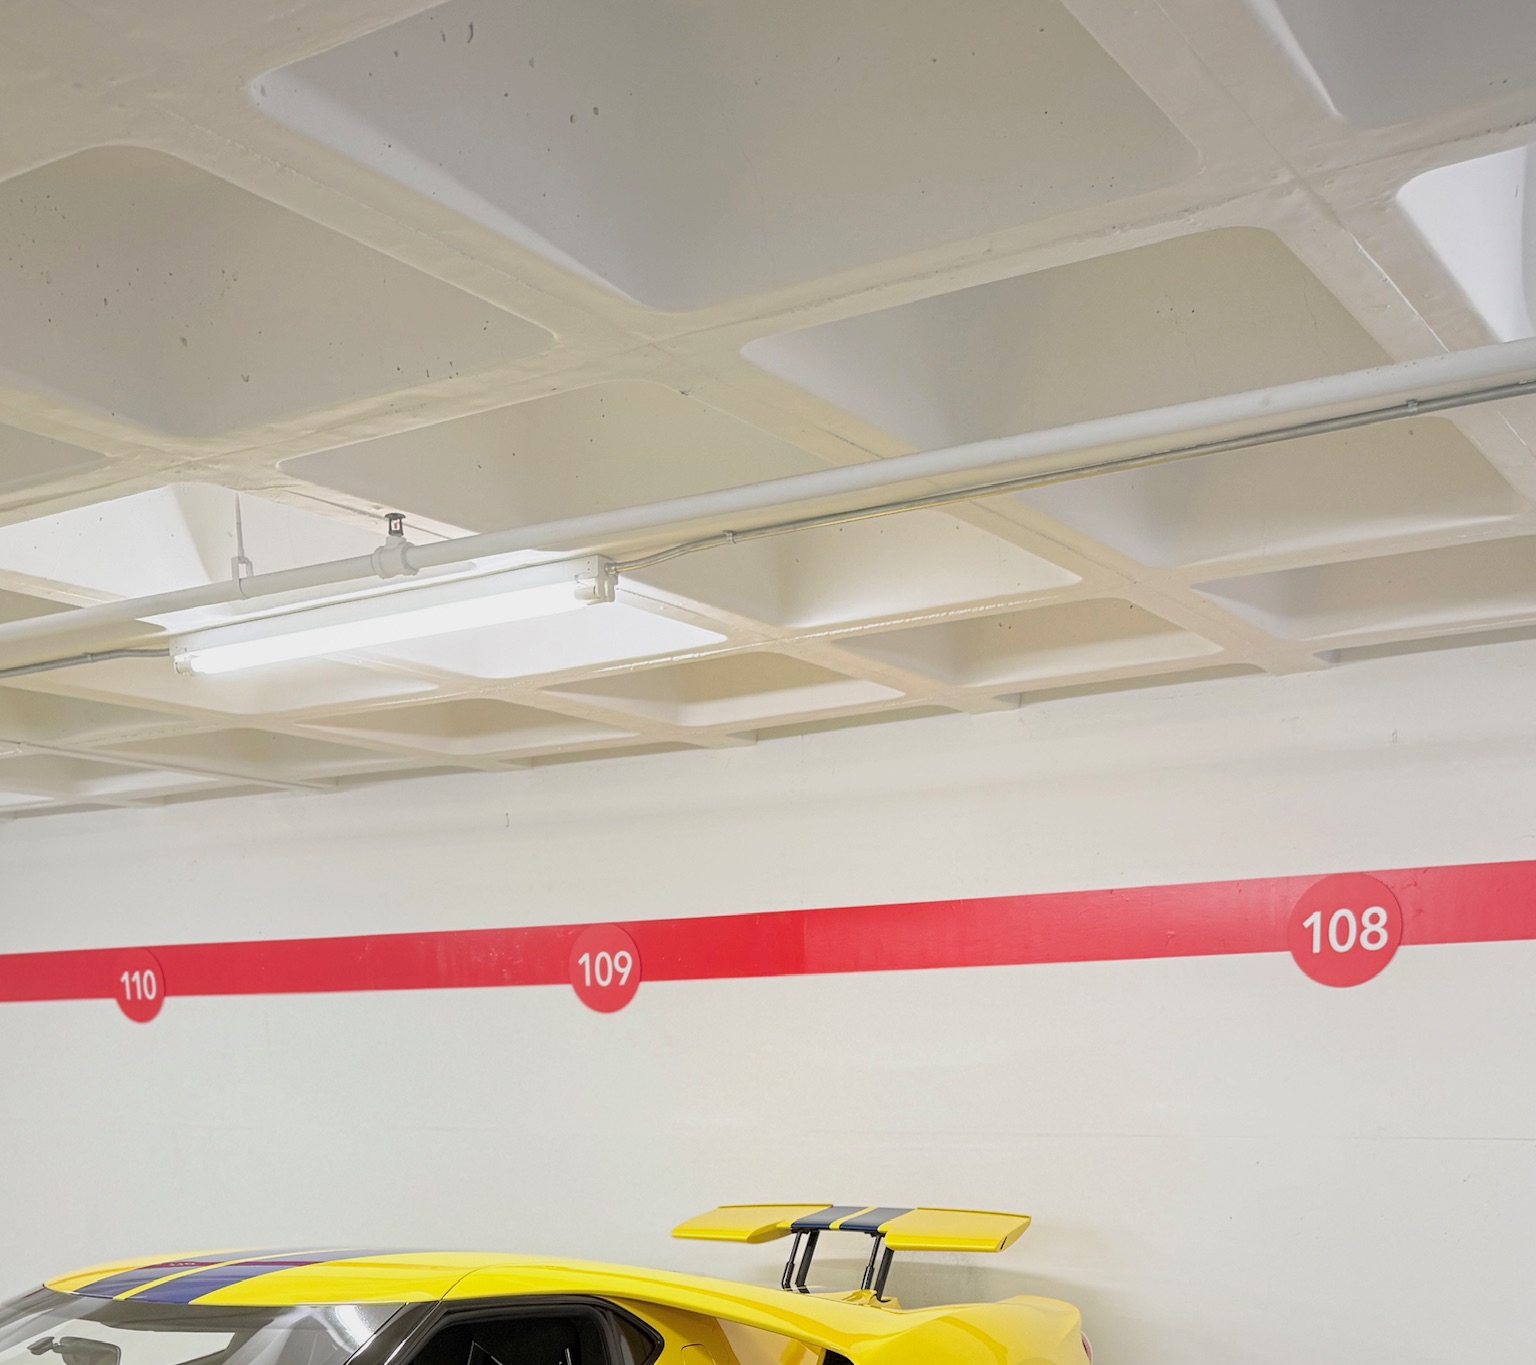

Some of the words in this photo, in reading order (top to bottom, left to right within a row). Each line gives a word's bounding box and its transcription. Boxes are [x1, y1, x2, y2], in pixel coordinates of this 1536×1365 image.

[1302, 906, 1388, 954] 108
[120, 969, 157, 1001] 110
[577, 949, 633, 987] 109
